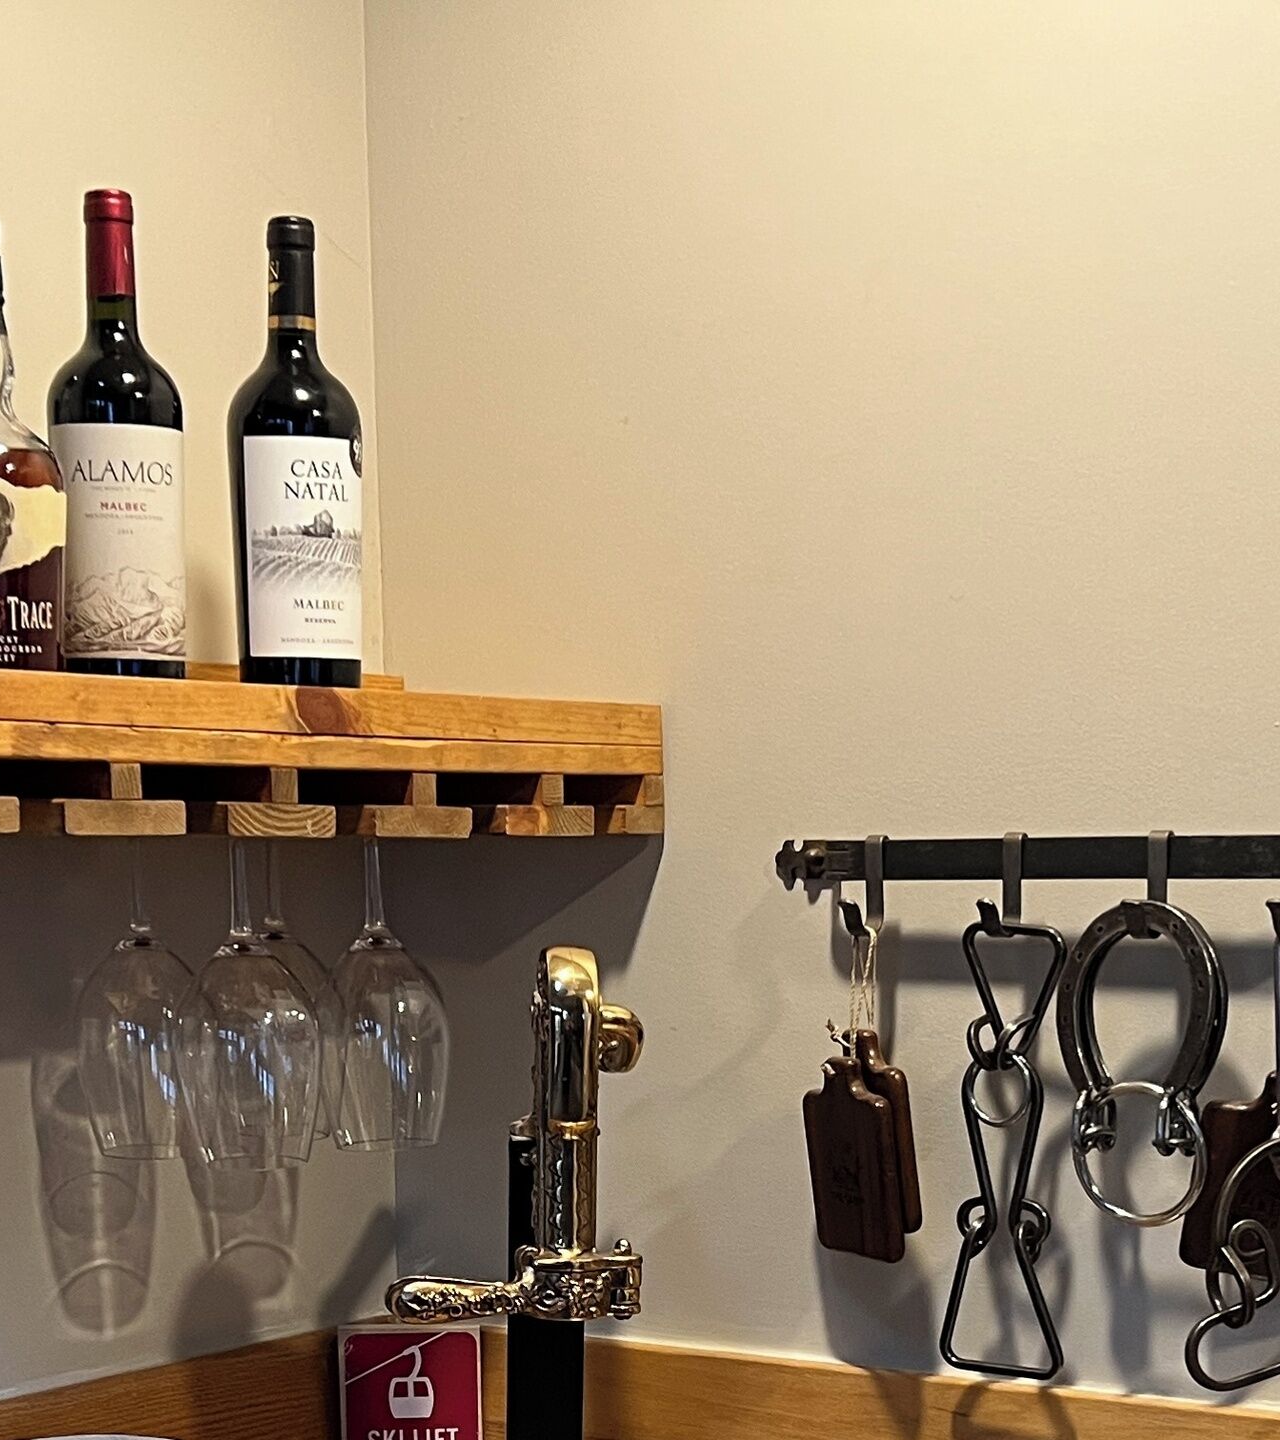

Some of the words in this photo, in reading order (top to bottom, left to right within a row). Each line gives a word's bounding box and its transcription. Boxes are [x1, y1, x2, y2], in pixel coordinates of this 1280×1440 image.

[70, 459, 173, 486] ALAMOS
[290, 459, 342, 480] CASA
[283, 481, 349, 502] NATAL
[99, 501, 148, 512] MALBEC
[6, 596, 54, 631] TRACE
[293, 598, 345, 611] MALBEC
